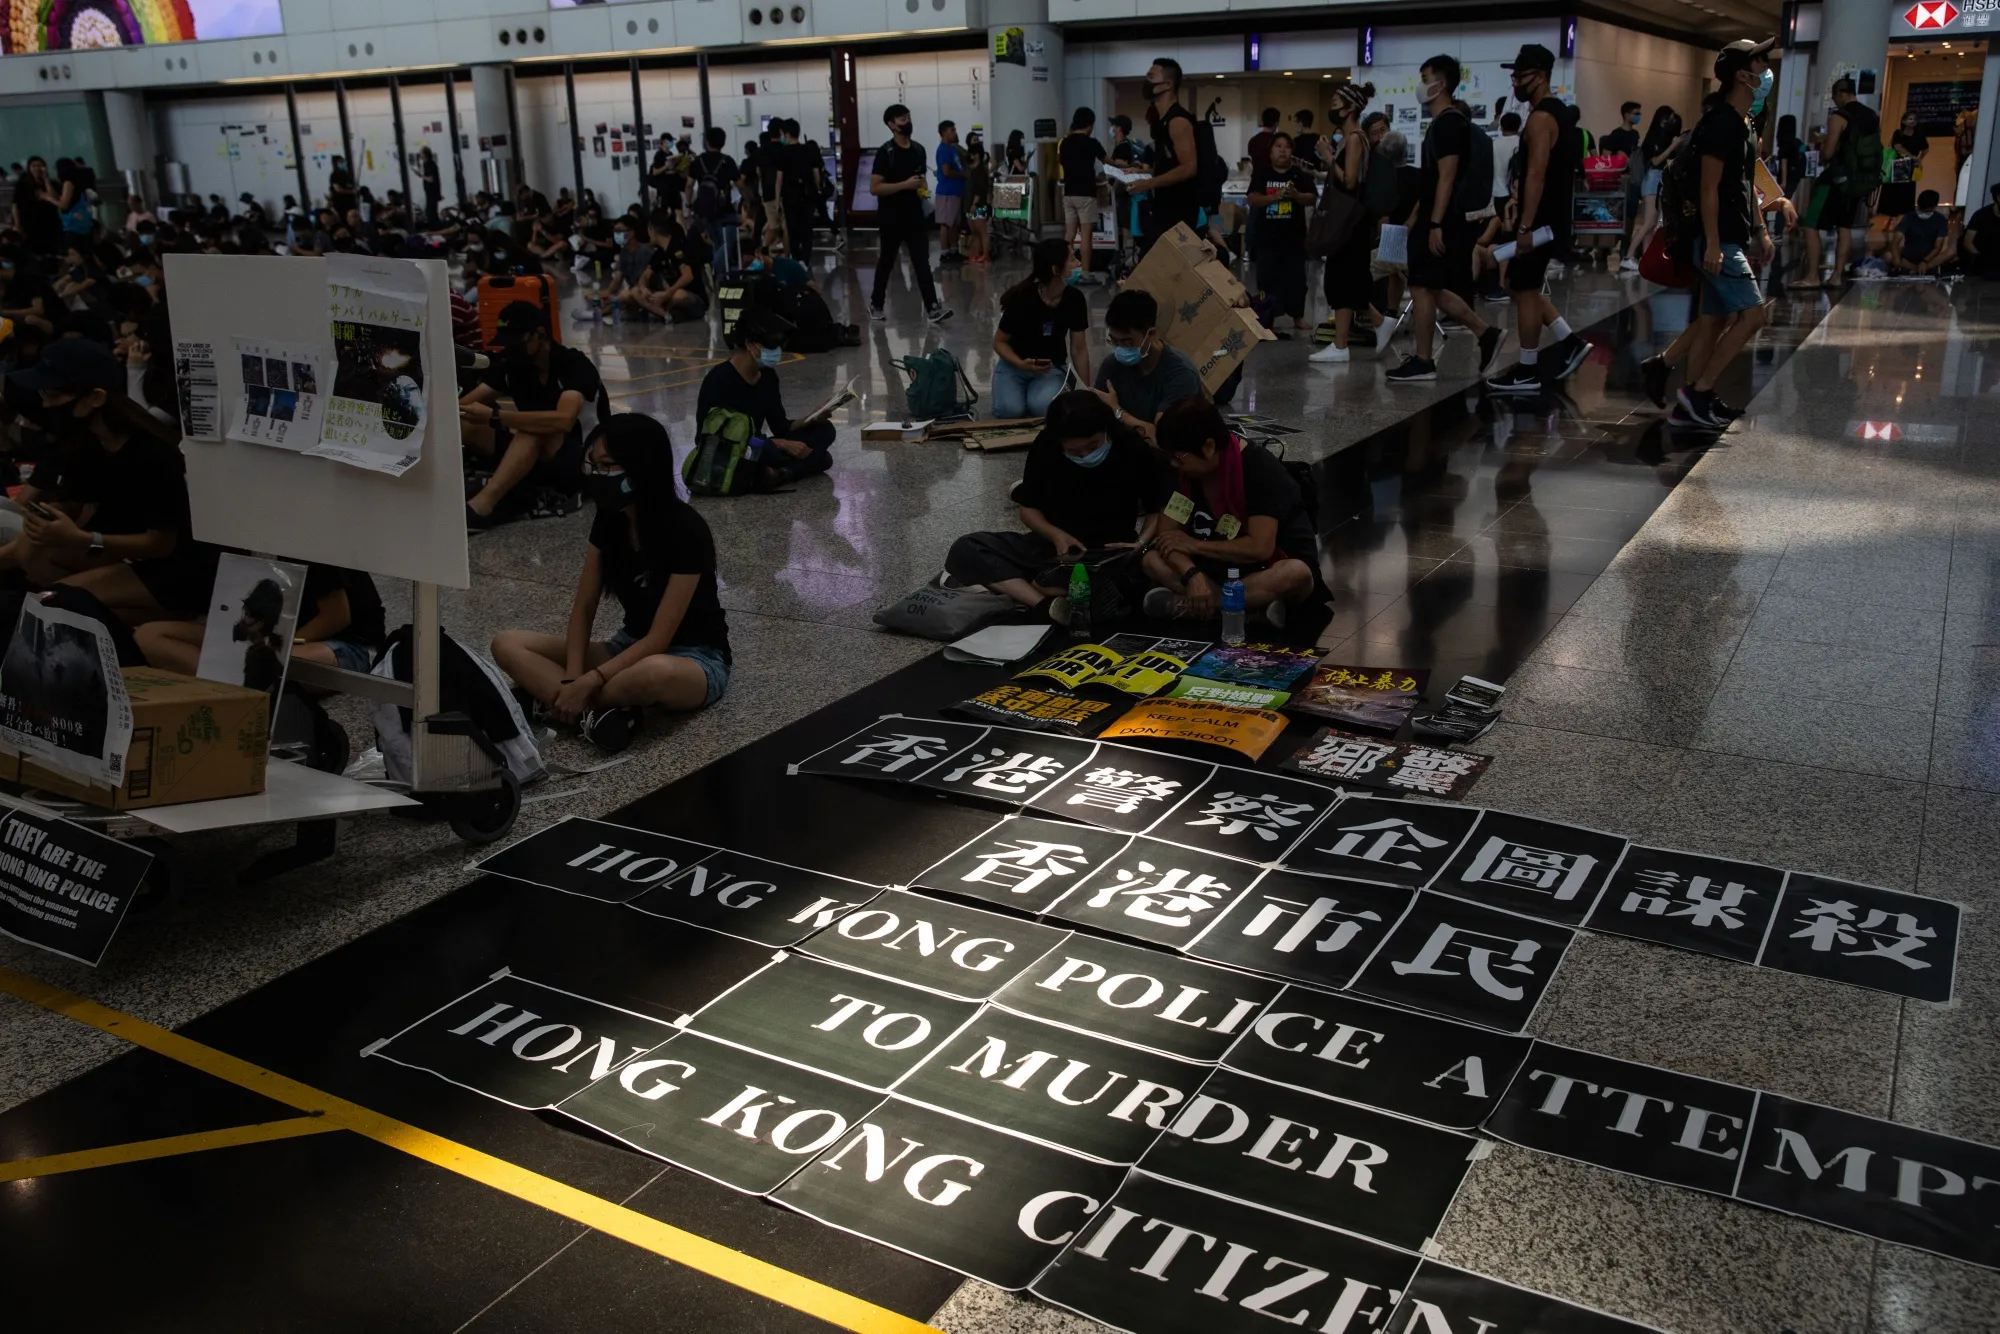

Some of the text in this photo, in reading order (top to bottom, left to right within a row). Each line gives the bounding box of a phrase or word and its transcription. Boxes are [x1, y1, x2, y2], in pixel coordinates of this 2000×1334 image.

[331, 284, 363, 298] リアル
[331, 304, 423, 328] サバイバルゲーム
[907, 604, 927, 616] ON
[1136, 655, 1182, 674] UP
[1324, 669, 1417, 692] 停止暴力
[974, 701, 1036, 723] EXTRADITION
[1050, 717, 1080, 727] CHINA
[1146, 712, 1240, 729] KEEP CALM
[1119, 727, 1240, 747] DON'T SHOOT
[3, 818, 108, 882] THEY ARE THE
[840, 731, 1938, 971] 香港警察企圖謀殺
[24, 862, 61, 893] KONG
[58, 878, 120, 914] POLICE
[45, 900, 80, 918] unarmed
[961, 838, 1541, 1001] 香港市民
[566, 843, 777, 909] HONG
[787, 896, 1016, 972] KONG
[1035, 956, 1386, 1070] POLICE
[446, 1003, 697, 1101] HONG
[700, 1085, 985, 1207] KONG
[810, 993, 1390, 1195] TO MURDER
